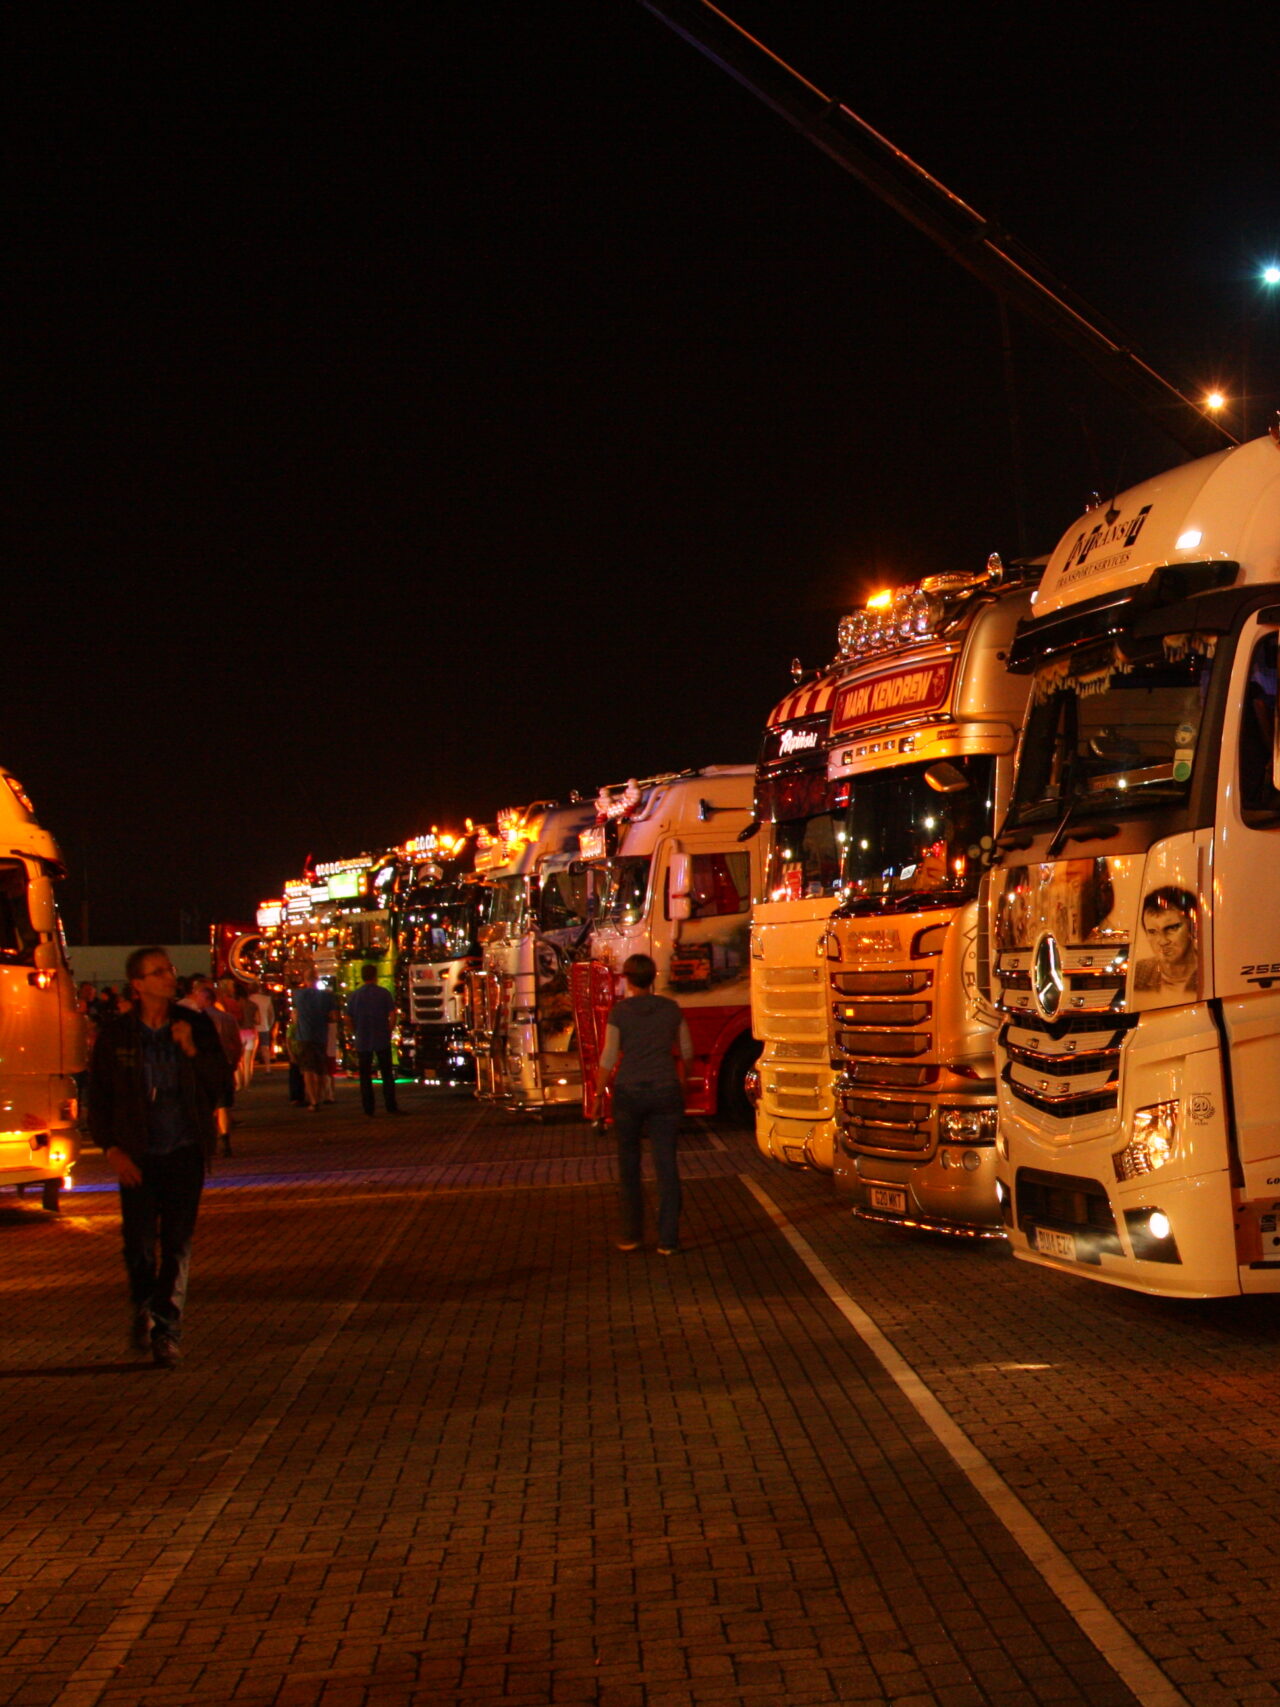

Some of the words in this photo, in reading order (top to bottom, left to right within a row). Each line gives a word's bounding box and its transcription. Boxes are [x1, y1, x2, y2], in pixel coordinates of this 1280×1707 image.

[1093, 551, 1132, 575] SERVICES
[842, 685, 872, 721] MARK
[870, 670, 934, 712] KENDREW
